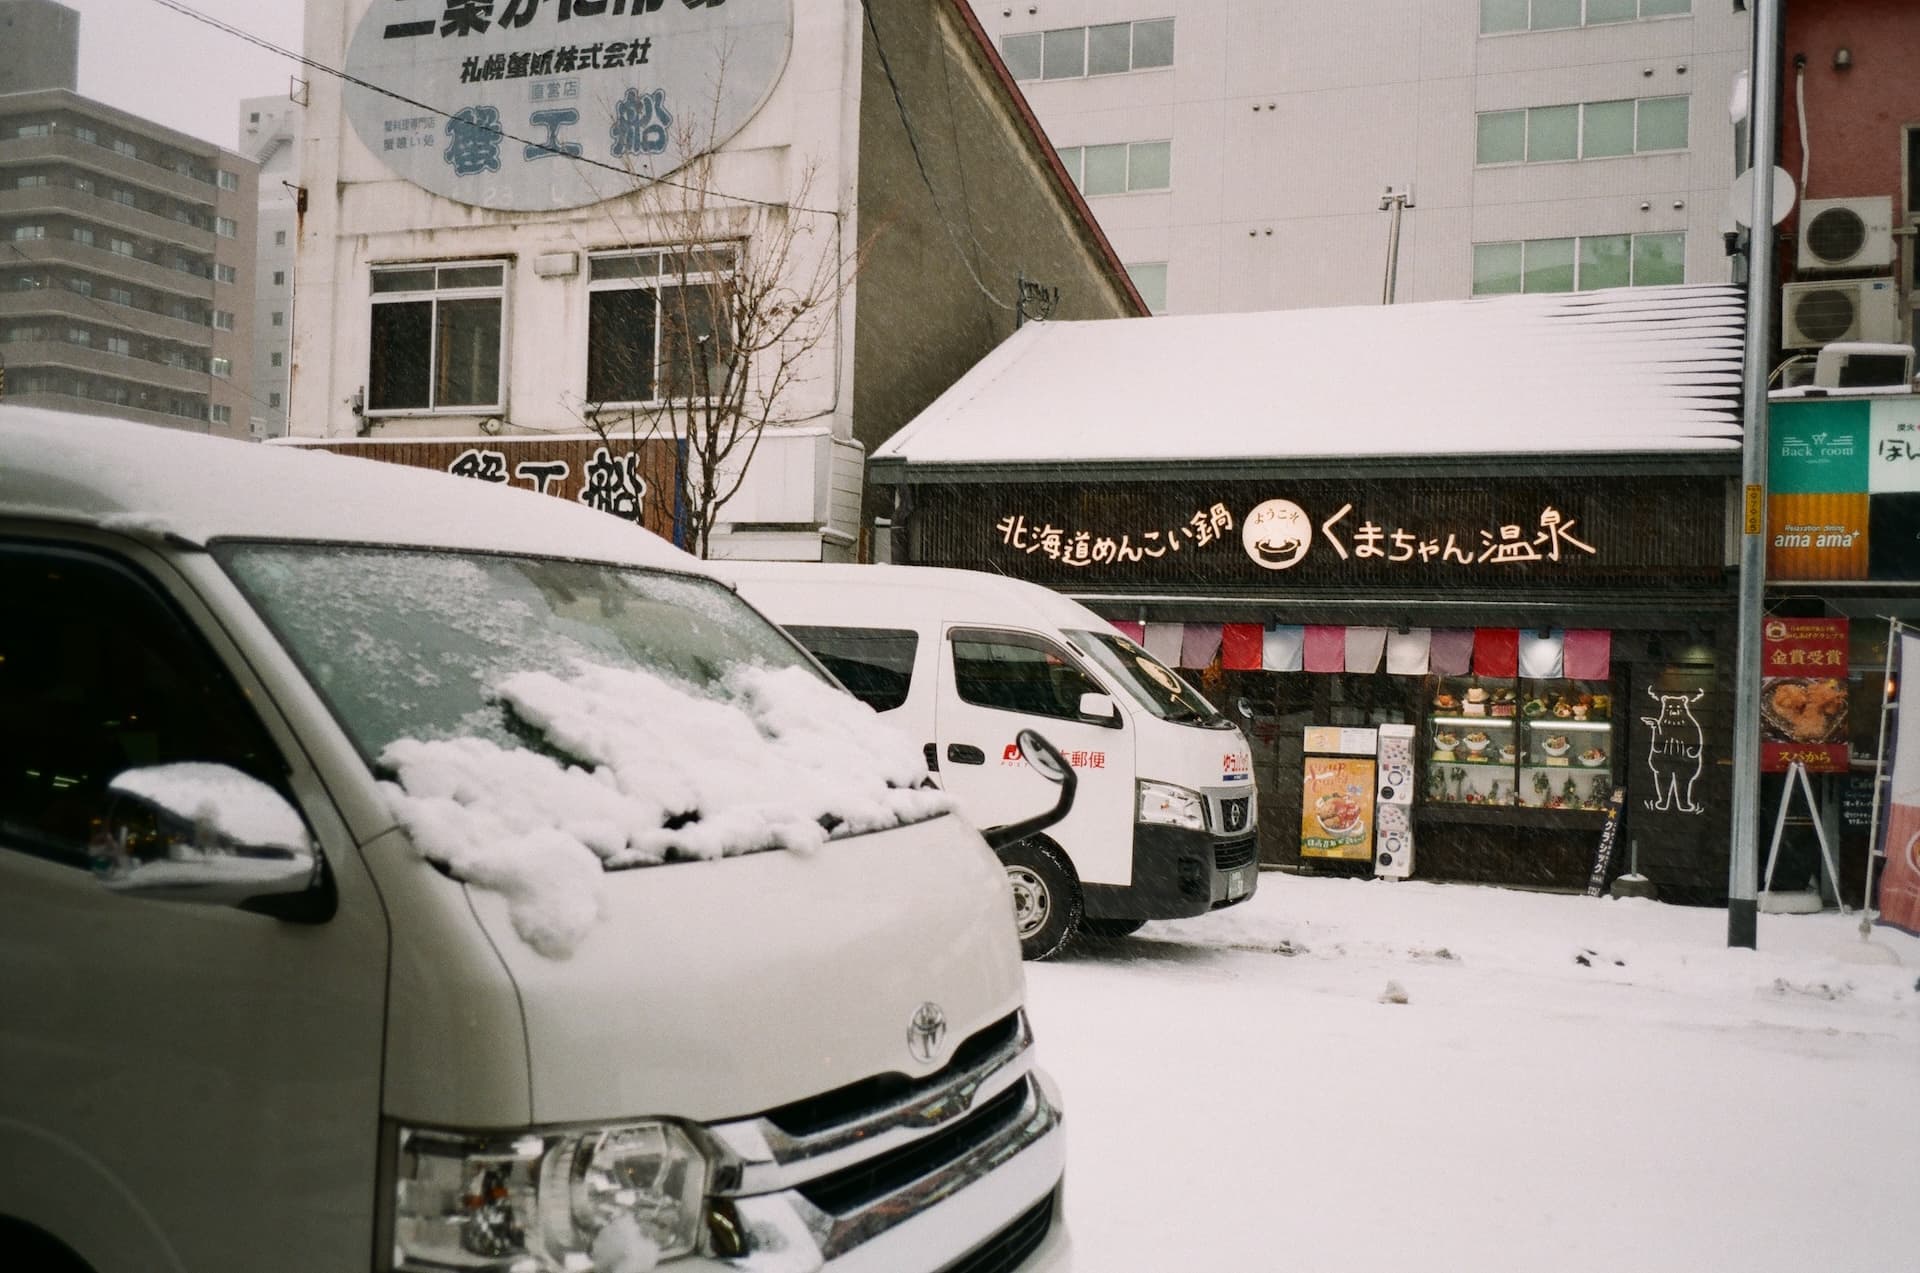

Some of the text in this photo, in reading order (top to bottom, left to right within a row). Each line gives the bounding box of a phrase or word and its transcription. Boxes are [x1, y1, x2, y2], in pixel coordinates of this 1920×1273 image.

[1782, 446, 1854, 457] Back room
[996, 502, 1597, 567] 北海道めんこい鍋 ようこそ くまちゃん温泉
[1775, 534, 1811, 548] ama
[1771, 649, 1843, 666] 金賞受賞
